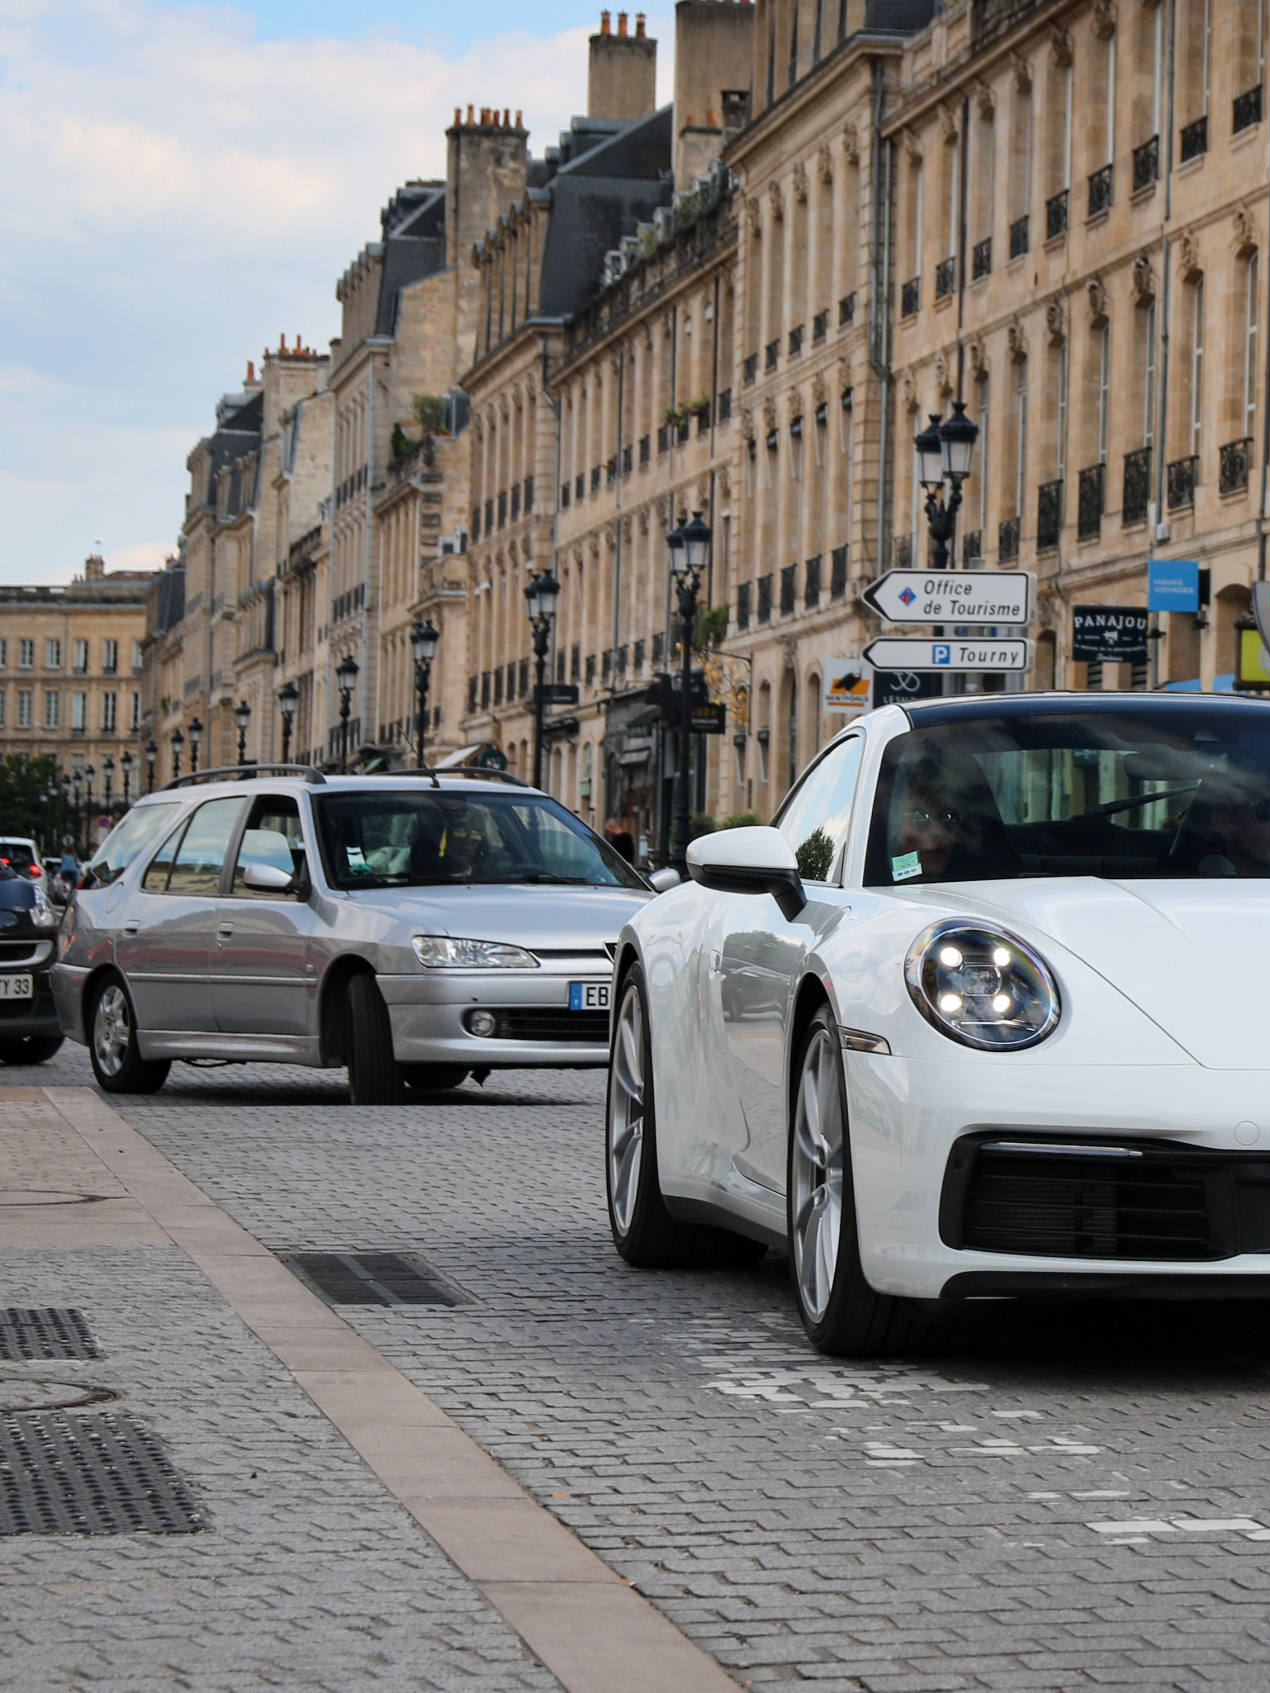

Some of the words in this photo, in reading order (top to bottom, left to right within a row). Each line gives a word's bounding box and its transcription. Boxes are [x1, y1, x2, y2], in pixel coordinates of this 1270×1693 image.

[924, 580, 972, 596] Office
[1154, 586, 1194, 594] VOYAGES
[924, 600, 942, 615] de
[950, 600, 1020, 617] Tourisme
[1074, 615, 1147, 630] PANAJOU
[959, 647, 1019, 665] Tourny
[14, 979, 29, 995] 33
